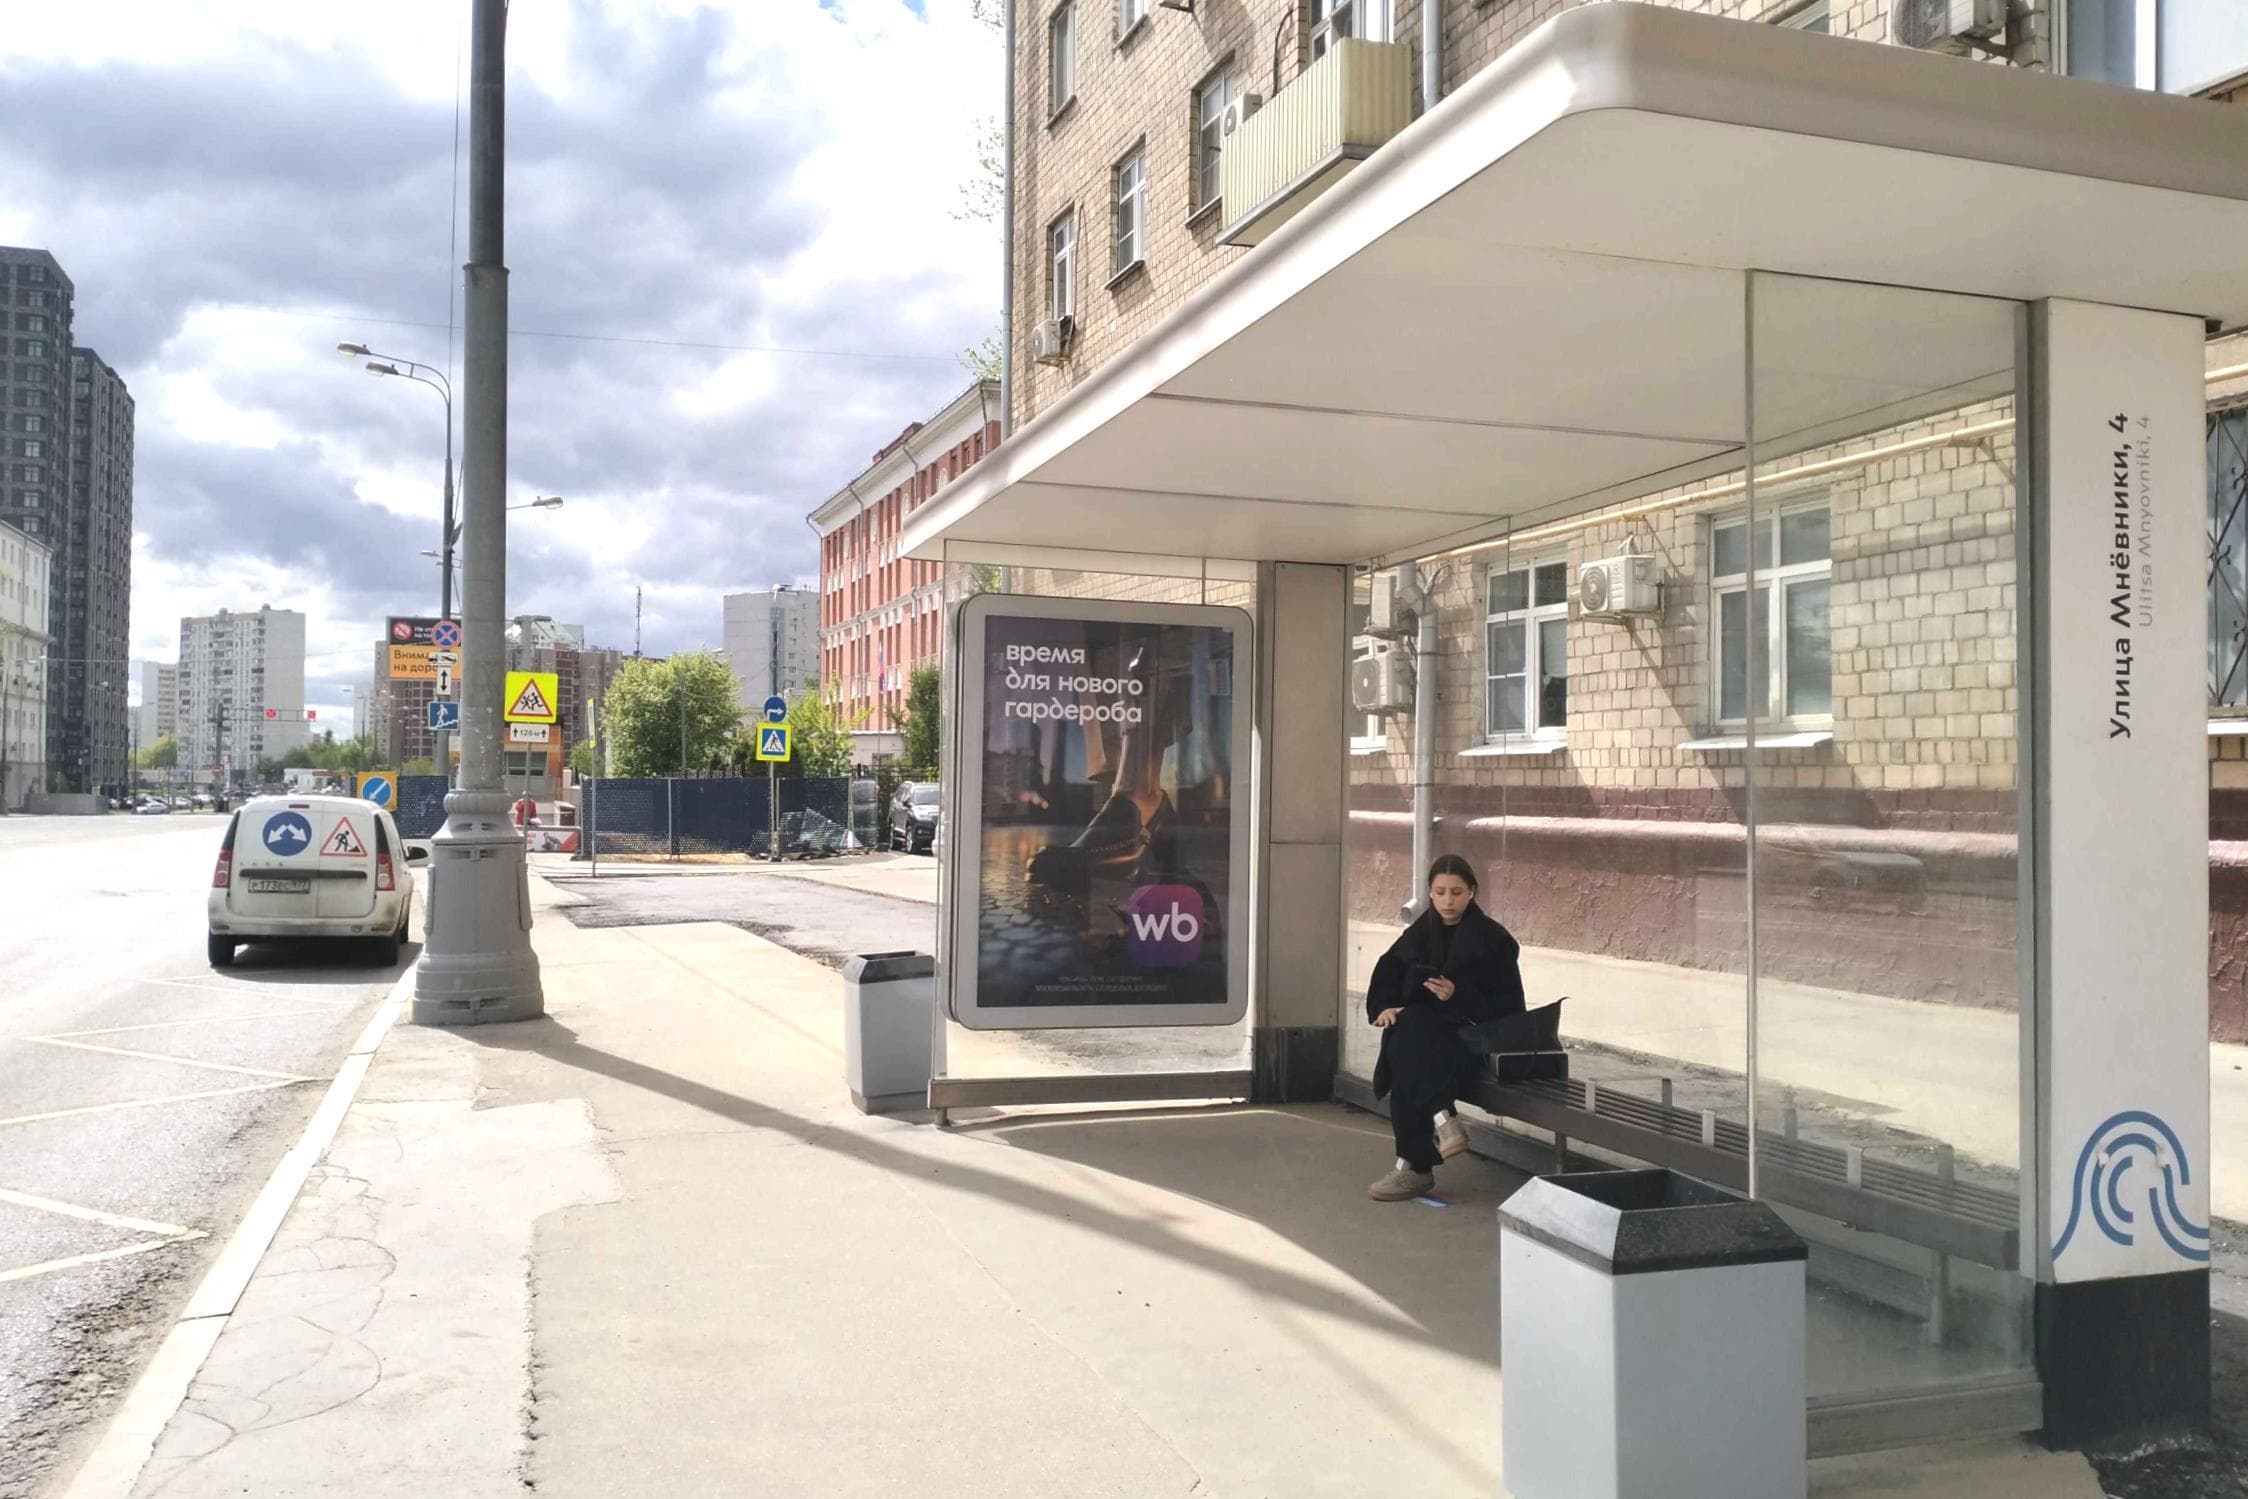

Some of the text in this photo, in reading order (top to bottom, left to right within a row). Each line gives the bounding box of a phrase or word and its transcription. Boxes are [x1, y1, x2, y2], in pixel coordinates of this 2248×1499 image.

[2135, 415, 2154, 628] Ulitsa Mnyovniki, 4
[2108, 412, 2134, 739] Улица Мнёвники, 4
[1005, 644, 1085, 667] время
[1005, 666, 1143, 695] для нового
[1004, 696, 1142, 726] гардероба
[1131, 901, 1199, 944] wb
